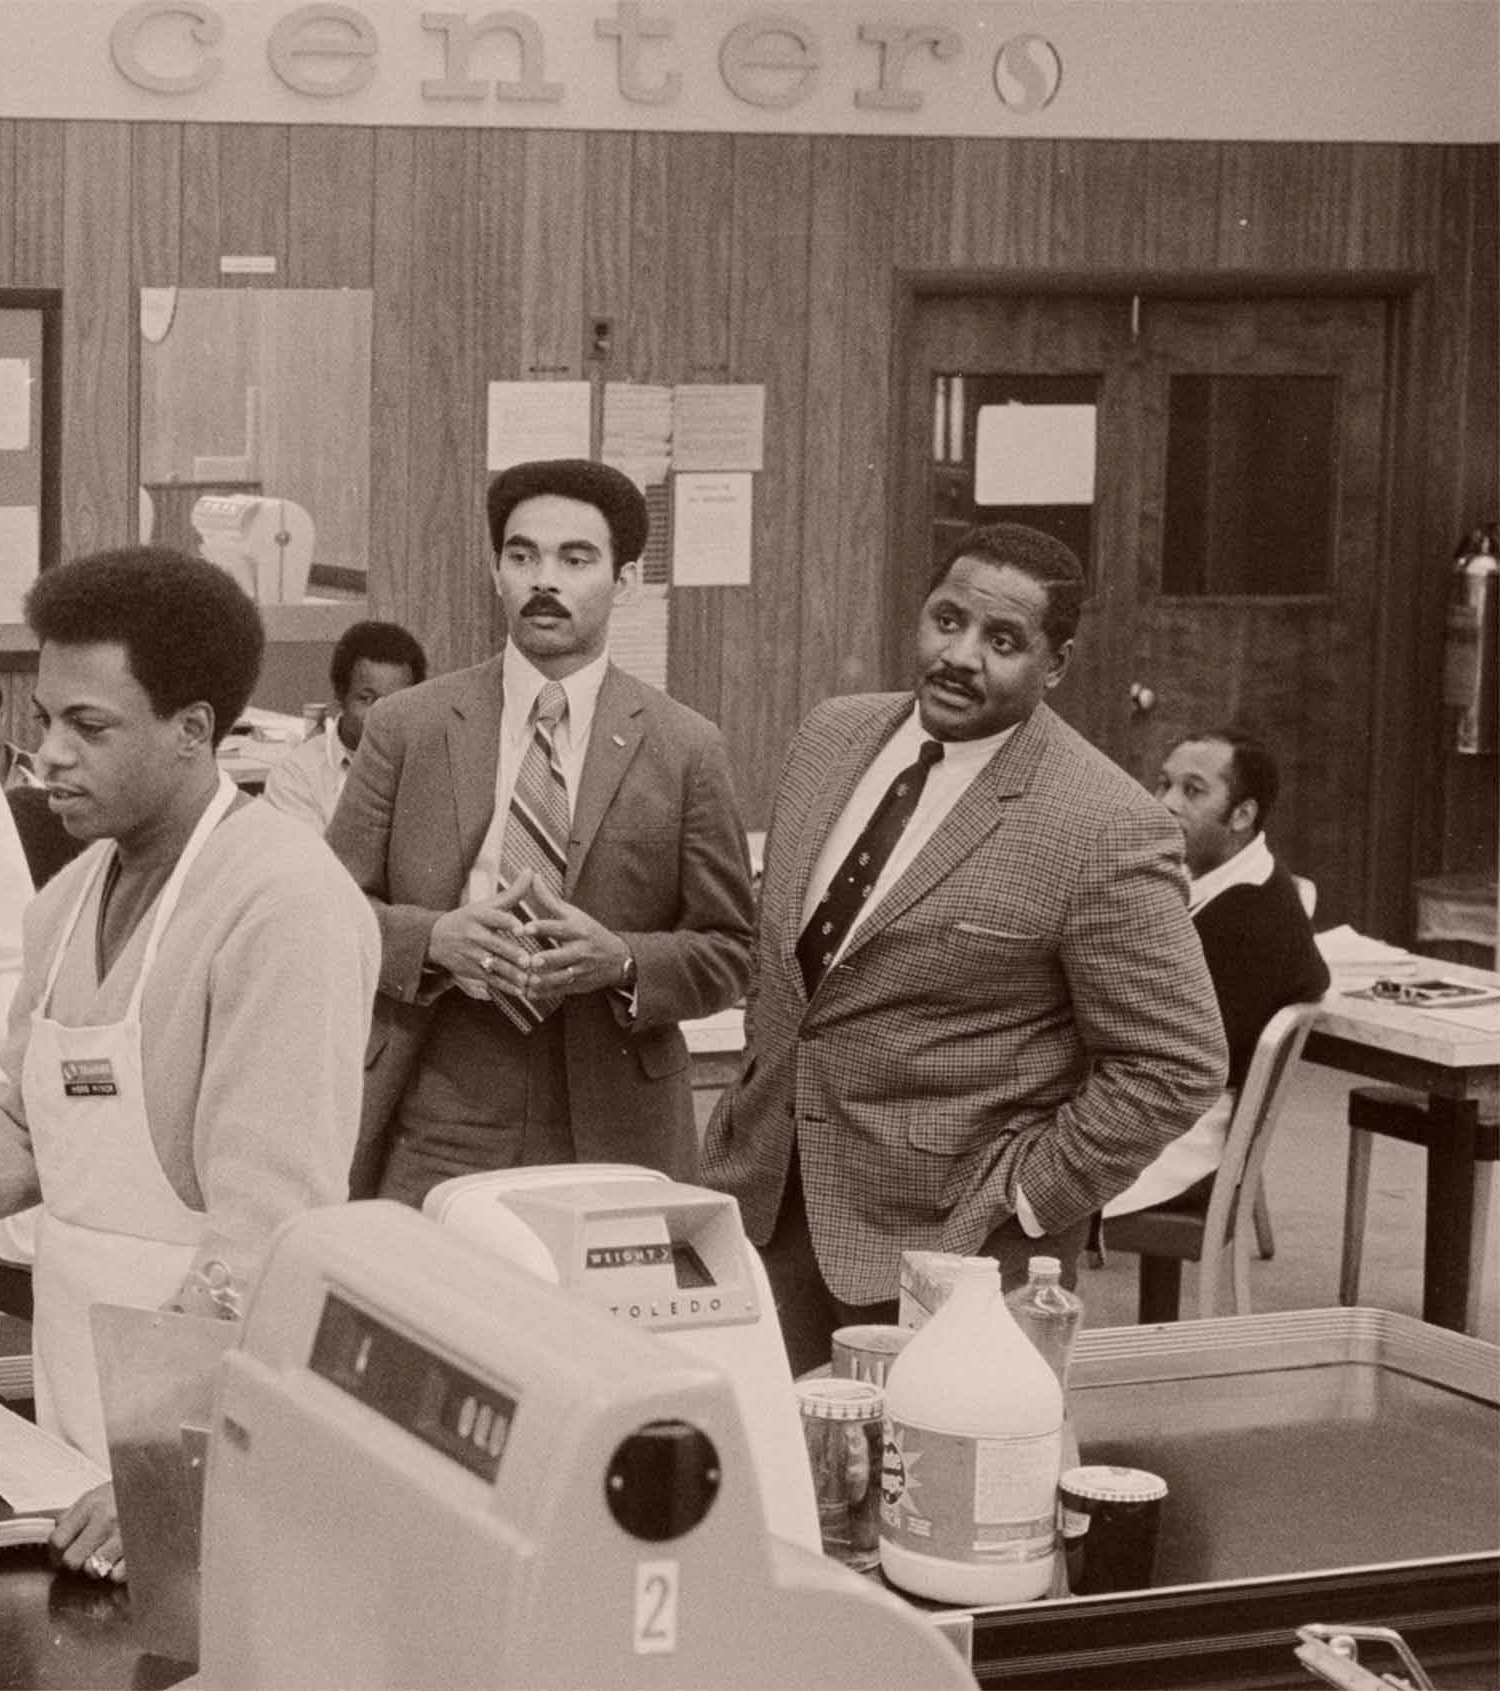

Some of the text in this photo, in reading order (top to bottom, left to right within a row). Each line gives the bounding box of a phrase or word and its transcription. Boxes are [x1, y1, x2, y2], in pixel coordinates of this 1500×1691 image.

[107, 0, 964, 113] center
[589, 1249, 656, 1267] WEIGHT
[609, 1297, 723, 1321] TOLEDO
[640, 1574, 670, 1641] 2
